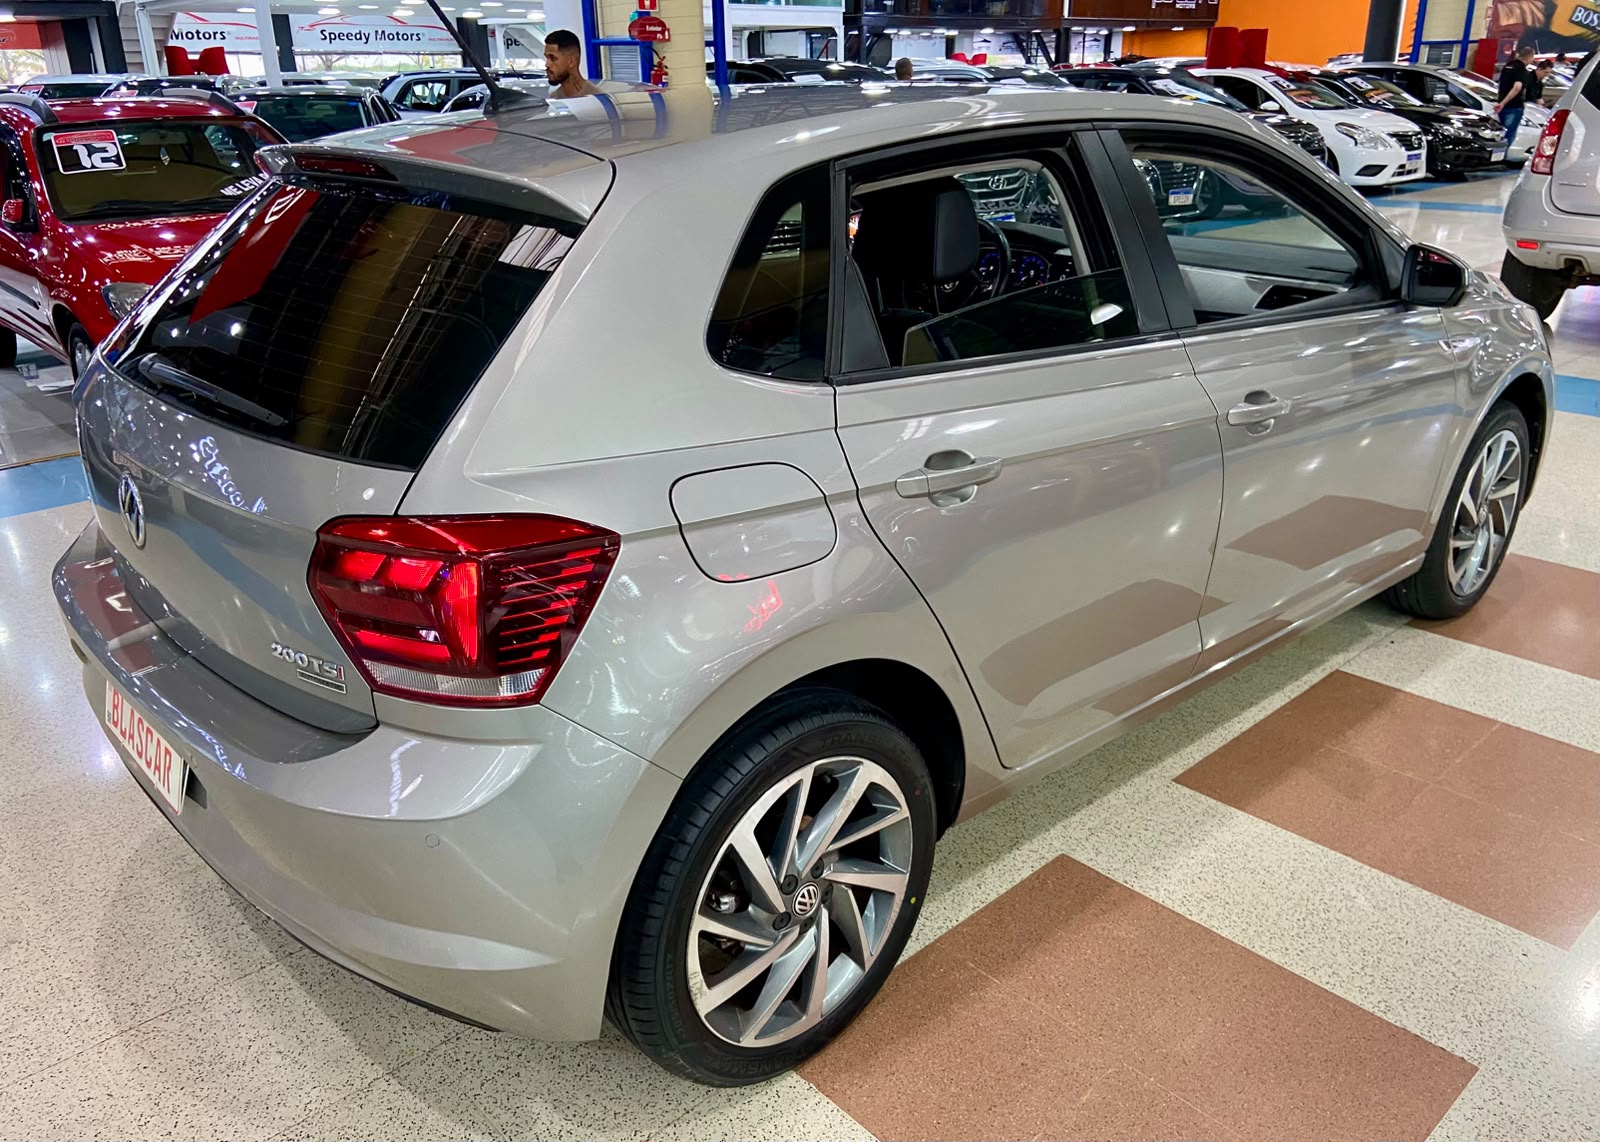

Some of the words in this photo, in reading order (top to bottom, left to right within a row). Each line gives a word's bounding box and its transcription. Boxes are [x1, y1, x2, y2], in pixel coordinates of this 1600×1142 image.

[1572, 6, 1600, 30] BOS
[170, 28, 226, 41] Motors
[320, 29, 370, 44] Speedy
[375, 30, 421, 42] Motors
[72, 142, 119, 169] 12
[220, 185, 243, 196] ME
[235, 176, 264, 192] LEVA
[111, 687, 173, 795] BLASCAR
